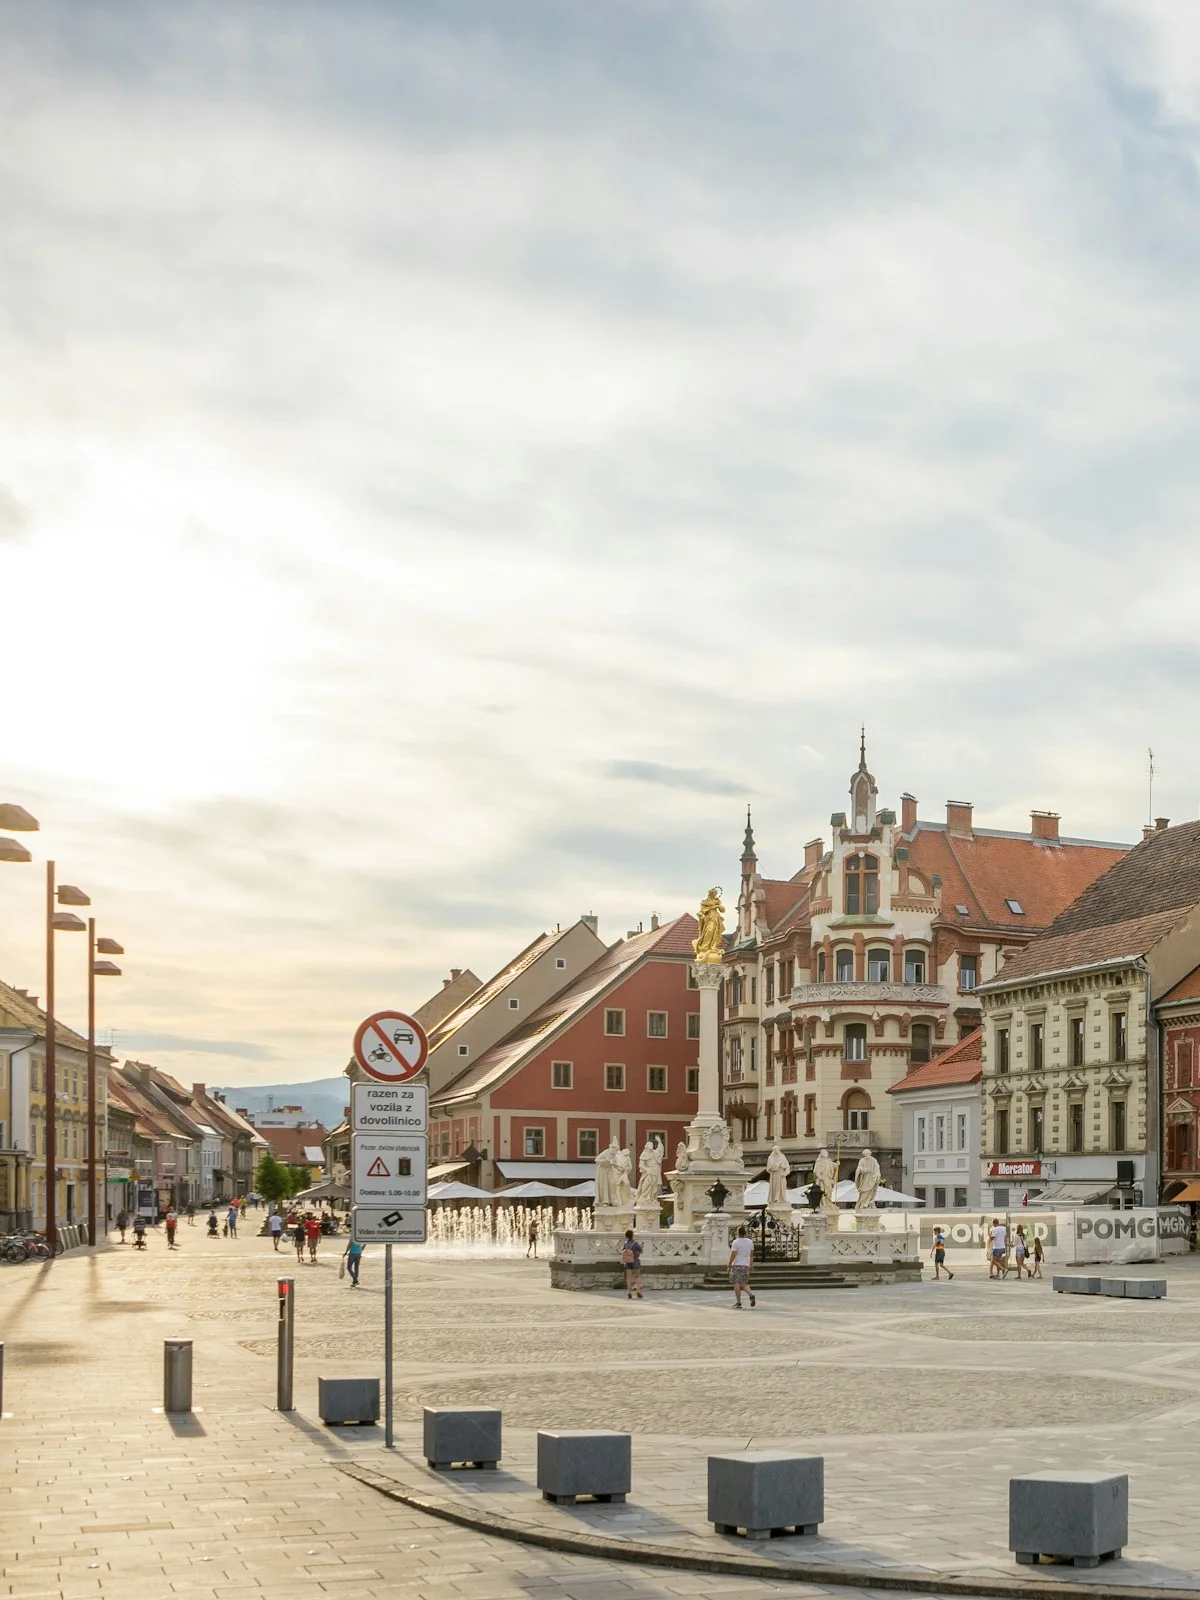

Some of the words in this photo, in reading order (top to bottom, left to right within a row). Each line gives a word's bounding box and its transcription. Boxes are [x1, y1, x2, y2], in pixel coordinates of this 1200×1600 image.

[367, 1090, 398, 1098] razen
[401, 1091, 414, 1099] za
[370, 1102, 402, 1112] vozila
[405, 1104, 412, 1112] z
[360, 1115, 422, 1126] dovolilnico
[998, 1162, 1035, 1175] Mercator
[1077, 1216, 1156, 1240] POMG
